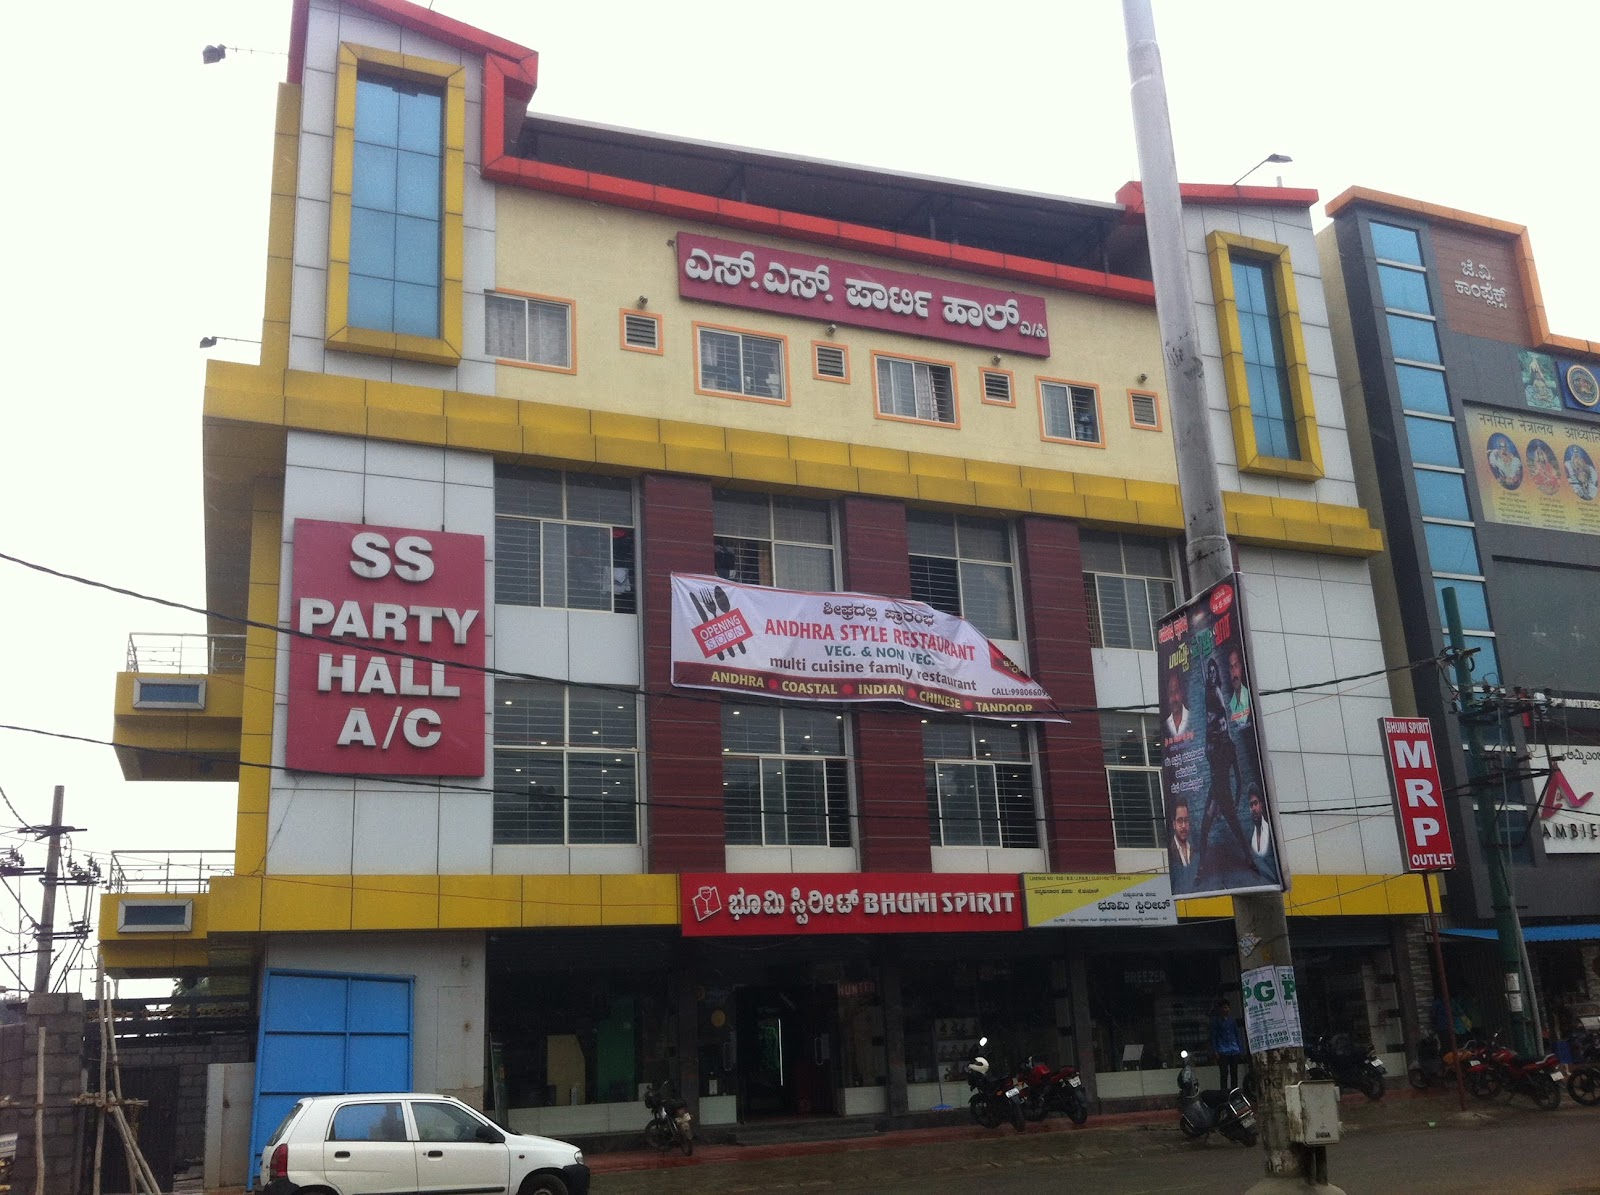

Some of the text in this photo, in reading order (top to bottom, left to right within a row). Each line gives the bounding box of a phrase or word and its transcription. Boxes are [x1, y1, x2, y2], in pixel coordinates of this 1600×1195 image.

[942, 295, 1020, 331] ಹಾಲ್
[350, 531, 435, 583] SS
[299, 597, 480, 645] PARTY
[699, 614, 741, 641] OPENING
[765, 618, 975, 661] ANDHRA STYLE RESTAURANT
[824, 645, 935, 666] VEG. & NON VEG.
[318, 653, 461, 698] HALL
[770, 657, 977, 691] multi cuisine family restaurant
[711, 671, 1033, 713] ANDHRA COASTAL INDIAN CHINESE TANDOOR
[337, 706, 442, 750] A/C
[1386, 720, 1430, 734] BHUMI SPIRIT
[1412, 853, 1453, 866] OUTLET
[727, 887, 785, 920] ಭೂಮಿ
[863, 891, 1014, 916] BHUMI SPIRIT
[1098, 901, 1130, 911] ಭೂಮಿ
